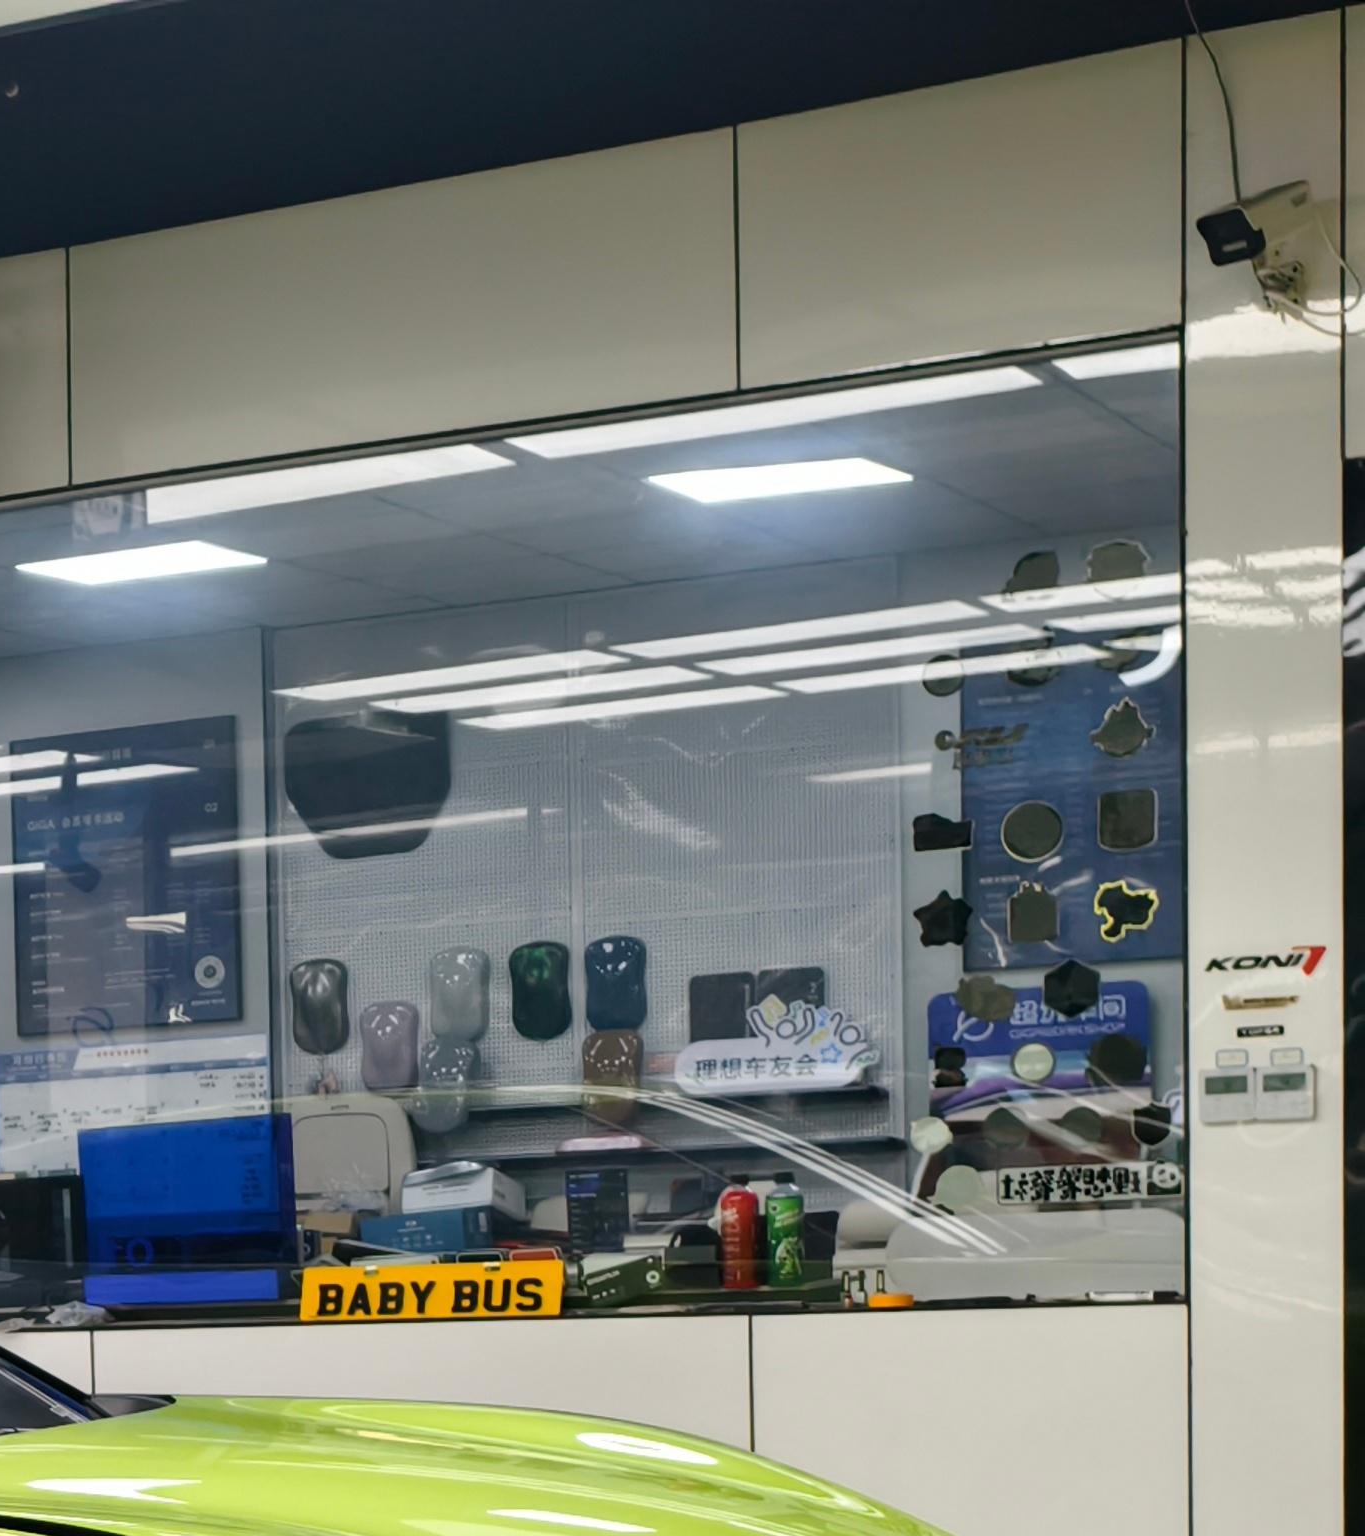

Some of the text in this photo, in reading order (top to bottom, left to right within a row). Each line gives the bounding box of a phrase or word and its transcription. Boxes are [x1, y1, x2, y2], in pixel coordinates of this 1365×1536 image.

[695, 1054, 818, 1081] 理想车友会
[316, 1280, 437, 1316] BABY
[451, 1277, 544, 1314] BUS
